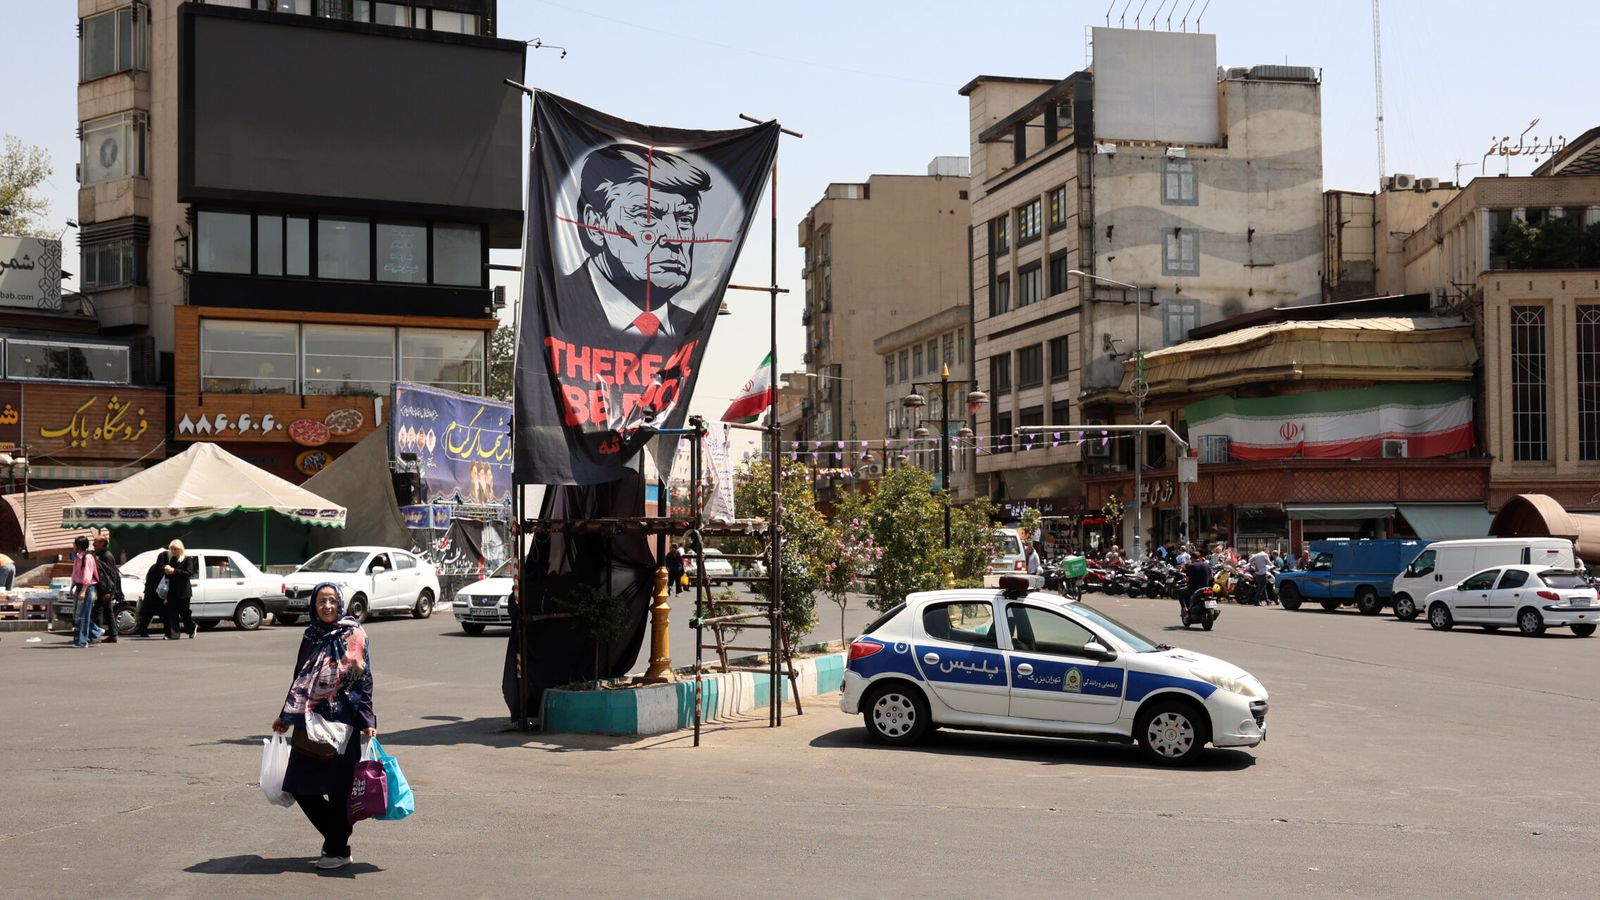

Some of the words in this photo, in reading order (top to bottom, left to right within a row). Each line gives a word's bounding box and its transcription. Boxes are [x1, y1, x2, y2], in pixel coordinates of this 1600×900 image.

[544, 336, 663, 388] THERE
[40, 396, 97, 447] بابک
[93, 395, 148, 441] فروشگاه
[940, 660, 999, 680] پلیس
[1027, 675, 1046, 684] بزرگ
[1046, 676, 1061, 684] تهران
